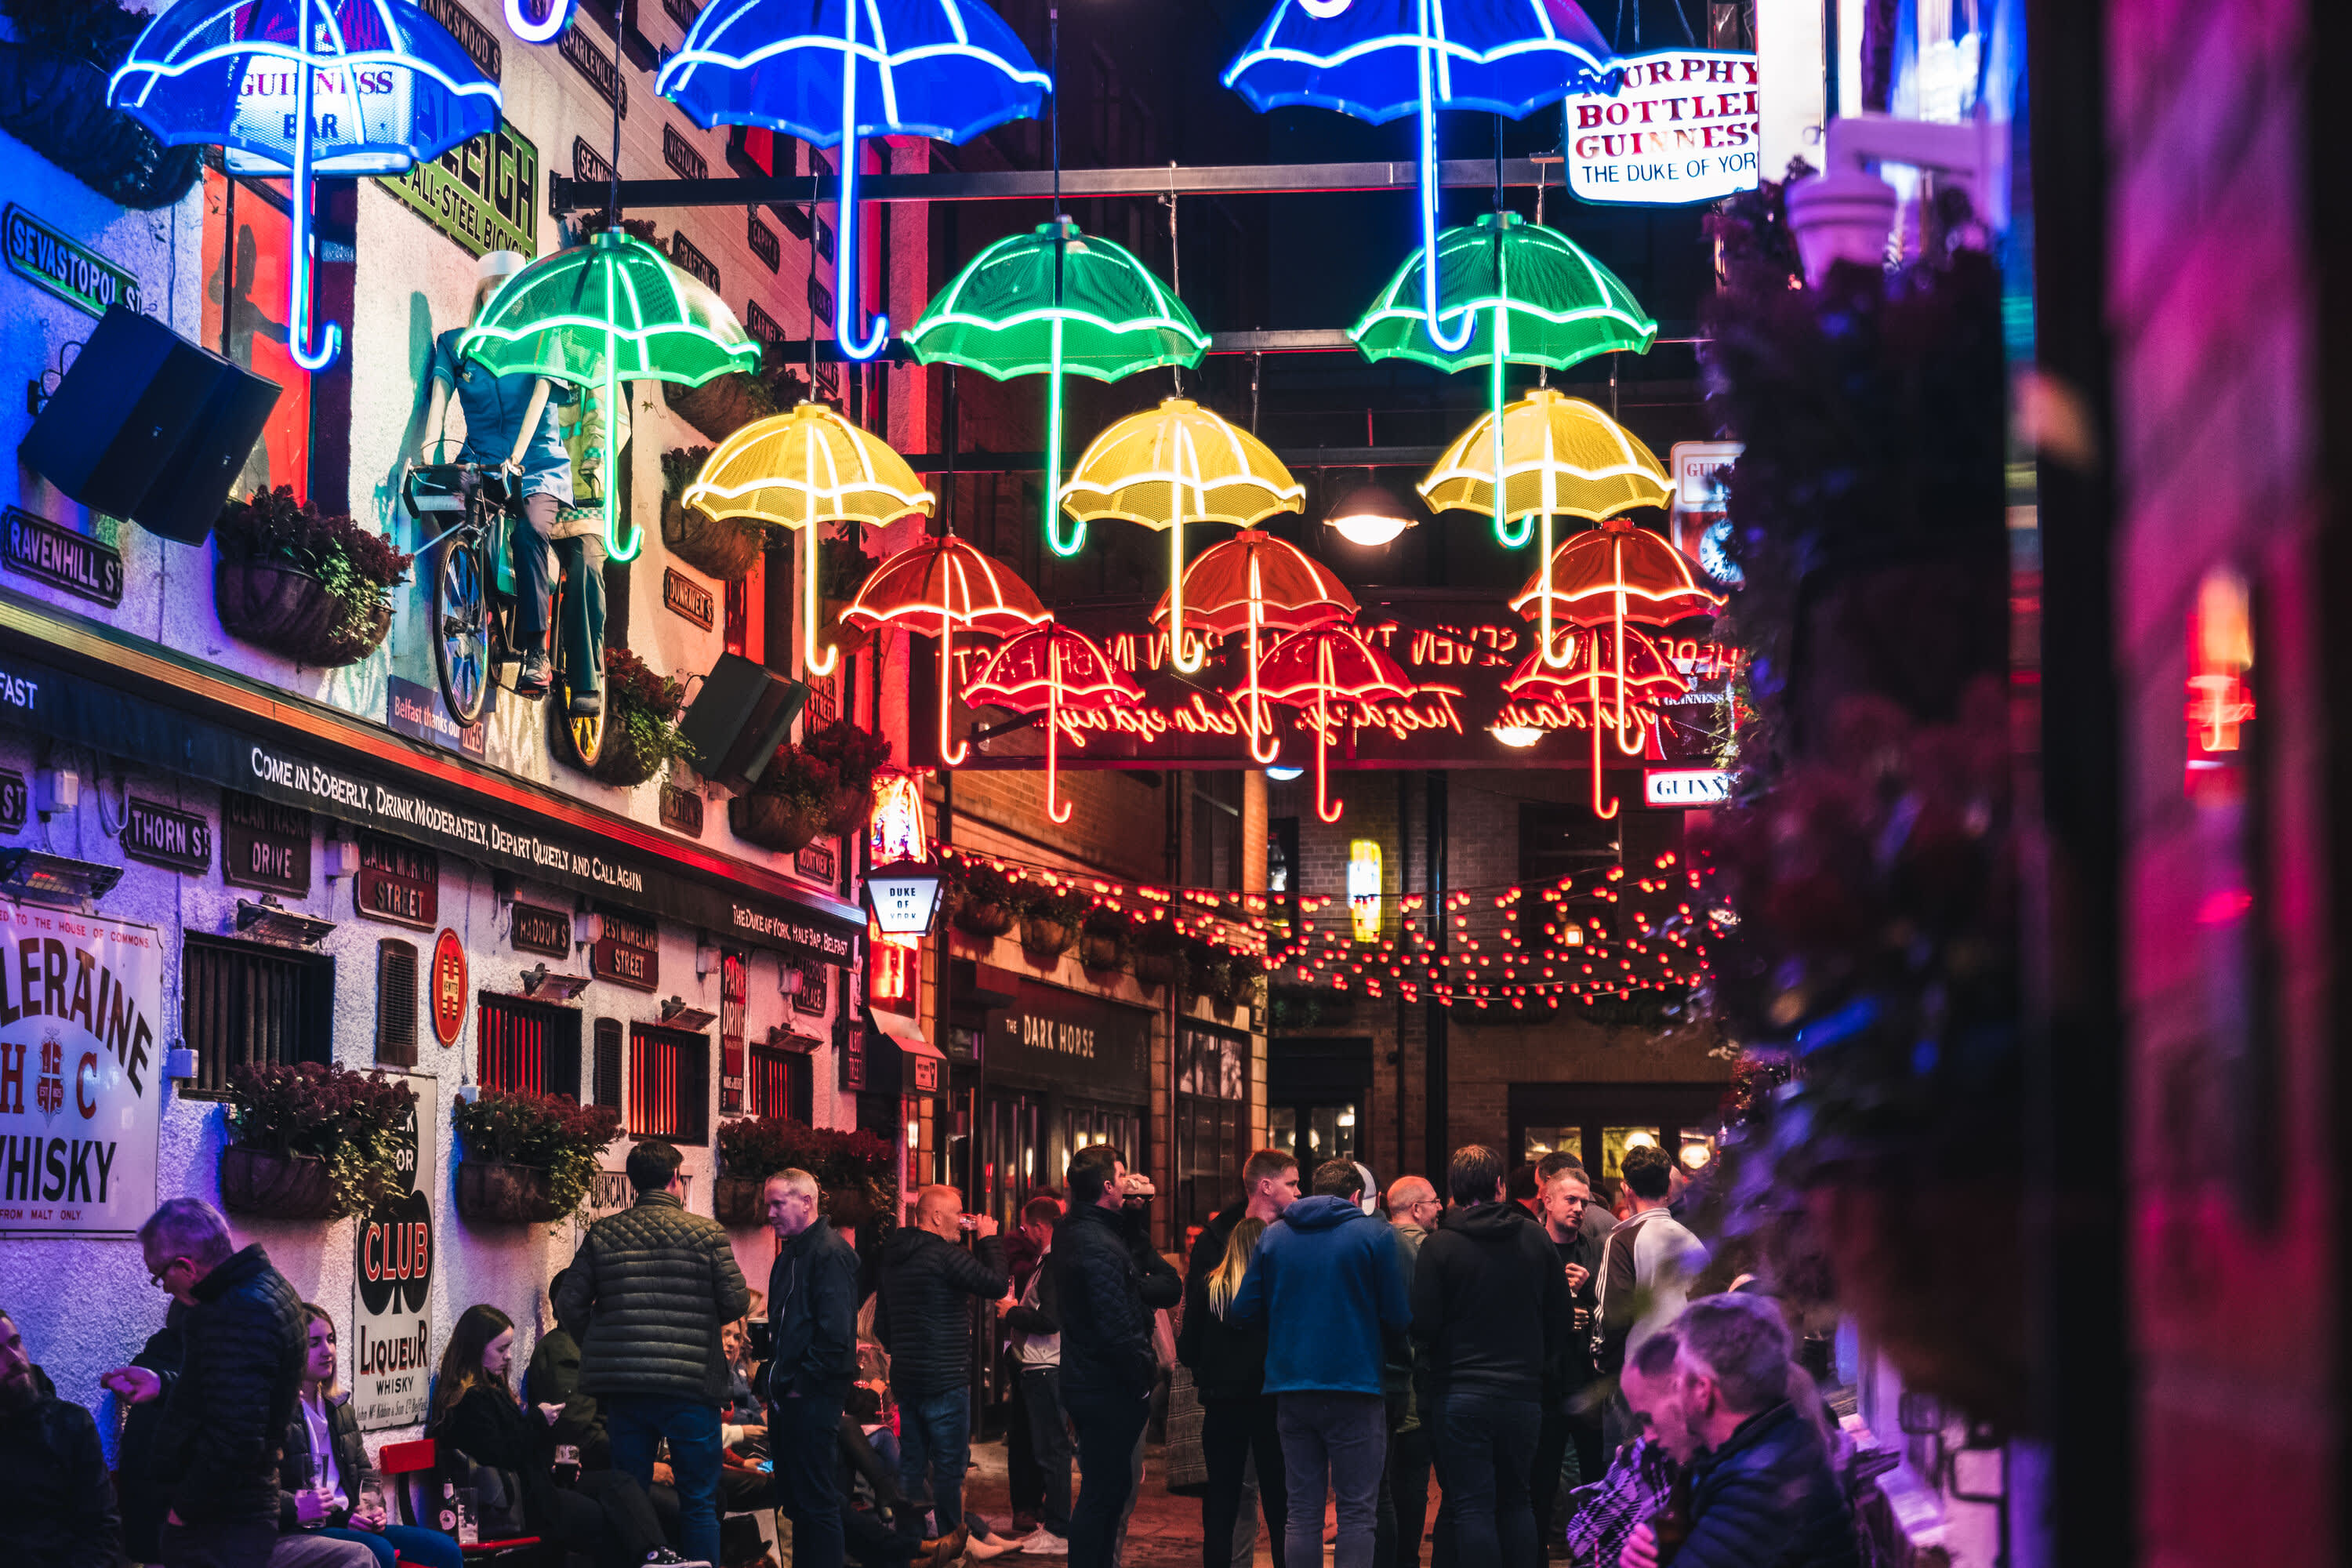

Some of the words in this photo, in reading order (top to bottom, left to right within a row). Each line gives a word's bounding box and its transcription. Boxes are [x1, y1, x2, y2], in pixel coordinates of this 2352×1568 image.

[241, 71, 393, 96] GUINESS
[1584, 59, 1757, 96] URPHY
[284, 113, 339, 139] BR
[1575, 122, 1757, 160] GUINNES
[1582, 165, 1620, 183] THE
[1628, 162, 1679, 182] DUKE
[1686, 158, 1711, 177] OF
[411, 162, 481, 245] ALL-STEEL
[10, 519, 100, 588] RAVENHILL
[670, 575, 704, 619] DUNRAVEN
[394, 696, 422, 724] Belfast
[423, 705, 448, 735] thanks
[132, 809, 187, 855] THORN
[251, 747, 292, 788] COME
[295, 765, 310, 792] IN
[312, 766, 373, 815] SOBERLY,
[376, 786, 414, 822] DRINK
[415, 798, 489, 851] MODERATELY,
[491, 824, 531, 859] DEPART
[532, 837, 569, 871] QUIETLY
[572, 855, 590, 877] AND
[592, 857, 616, 886] CALL
[617, 865, 643, 892] AGAIN
[252, 841, 292, 879] DRIVE
[377, 880, 424, 918] STREET
[890, 887, 916, 897] DUKE
[896, 900, 909, 909] OF
[16, 913, 28, 926] TO
[34, 917, 52, 930] THE
[59, 921, 86, 937] HOUSE
[93, 927, 104, 939] OF
[745, 909, 765, 932] DUKE
[823, 932, 848, 956] BELFAST
[615, 948, 645, 979] STREET
[1005, 1018, 1017, 1034] THE
[1023, 1014, 1054, 1051] DARK
[1059, 1023, 1094, 1058] HORSE
[31, 1210, 56, 1221] MALT
[365, 1221, 429, 1282] CLUB
[360, 1319, 428, 1377] LIQUEUR
[376, 1376, 414, 1396] WHISKY
